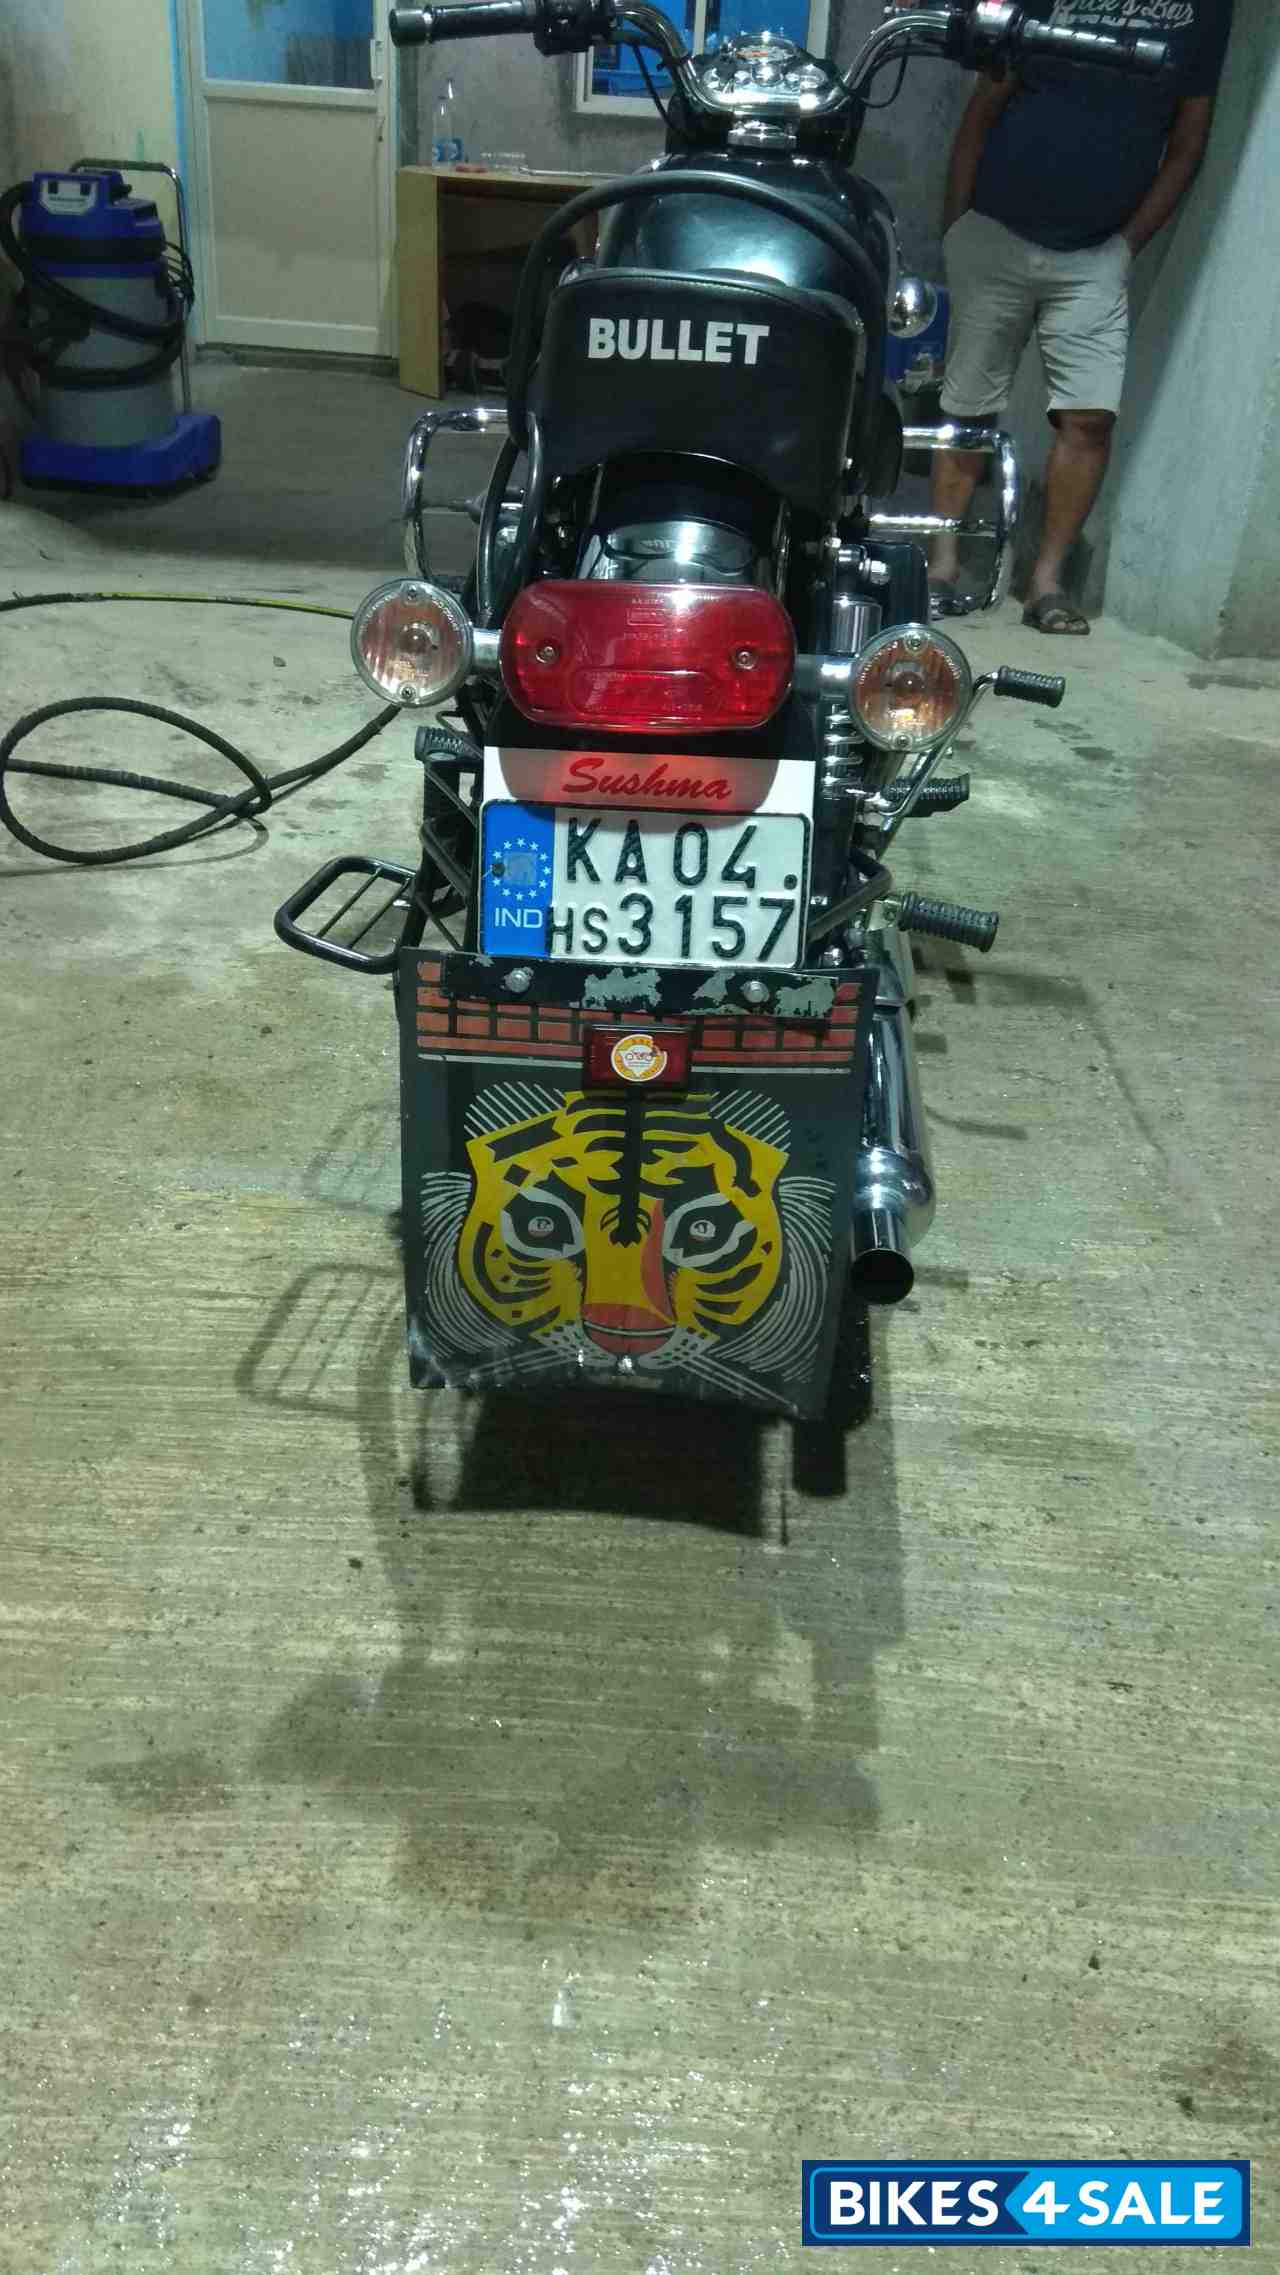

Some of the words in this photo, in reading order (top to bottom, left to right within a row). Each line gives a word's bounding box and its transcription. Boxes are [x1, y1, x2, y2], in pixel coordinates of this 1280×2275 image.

[588, 317, 770, 365] BULLET
[562, 757, 733, 801] Sushma
[494, 906, 544, 929] IND
